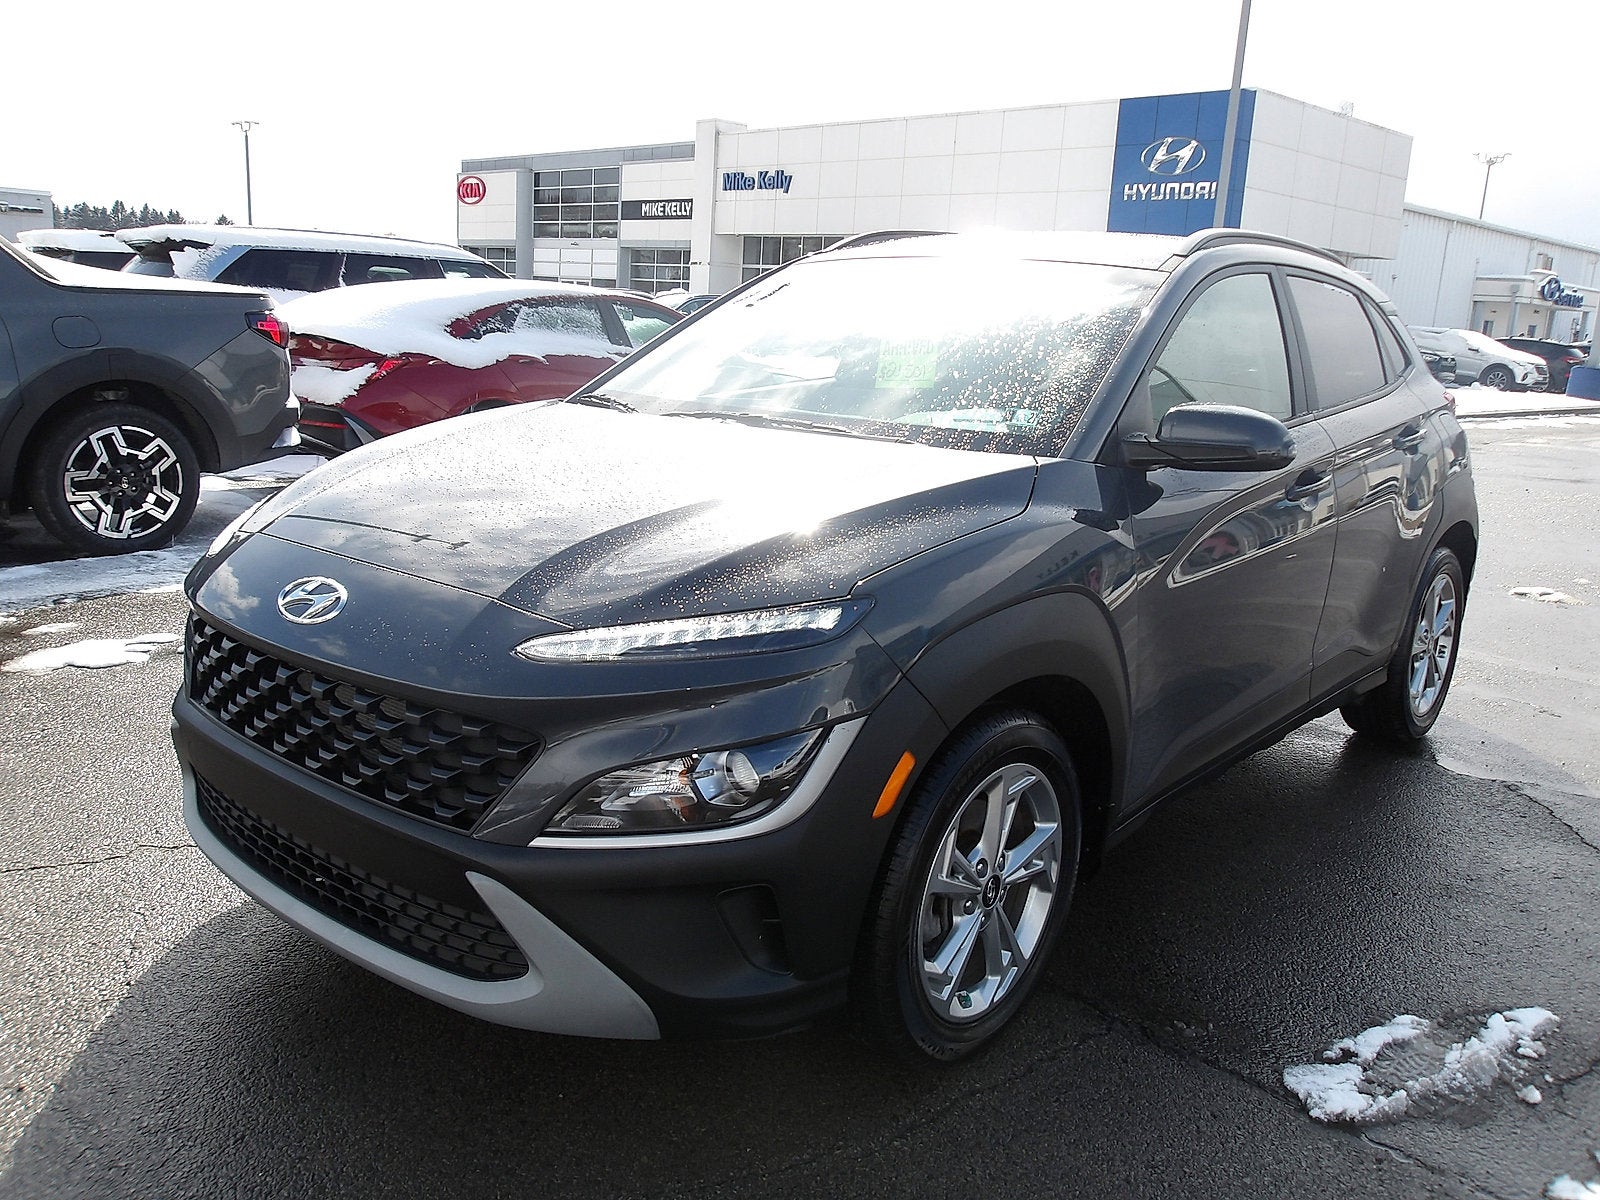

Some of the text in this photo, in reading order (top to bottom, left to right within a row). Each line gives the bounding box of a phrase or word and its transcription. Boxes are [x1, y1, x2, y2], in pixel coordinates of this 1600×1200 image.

[461, 182, 481, 199] KIA
[722, 170, 793, 193] Mike Kelly
[1123, 181, 1217, 201] HYUNDAI
[641, 201, 692, 217] MIKE KELLY
